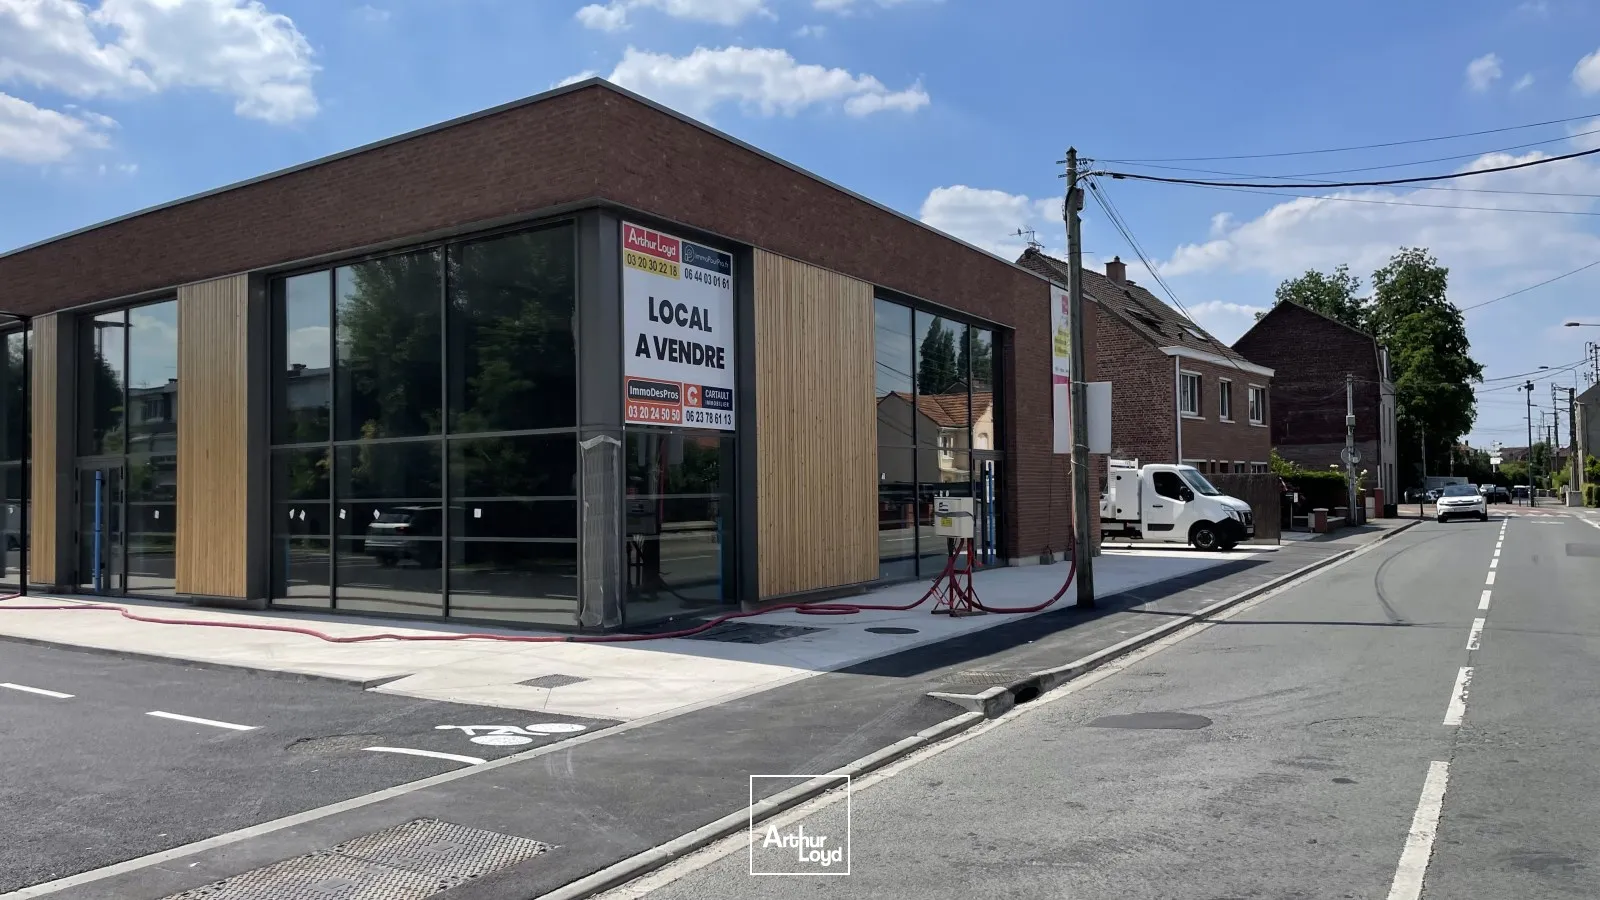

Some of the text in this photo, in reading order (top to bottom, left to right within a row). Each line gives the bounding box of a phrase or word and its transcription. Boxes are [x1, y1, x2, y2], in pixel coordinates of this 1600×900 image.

[628, 228, 677, 257] Arthur Loyd
[627, 253, 678, 277] 03 20 30 22 18
[684, 267, 730, 290] 06 44 03 01 61
[648, 296, 713, 333] LOCAL
[635, 333, 725, 370] A VENDRE
[629, 385, 679, 400] ImmoDesPros
[705, 389, 729, 401] CARTAULT
[628, 405, 680, 422] 03 20 24 50 50
[704, 400, 729, 408] IMMOBILIER
[686, 410, 732, 426] 06 23 78 61 13
